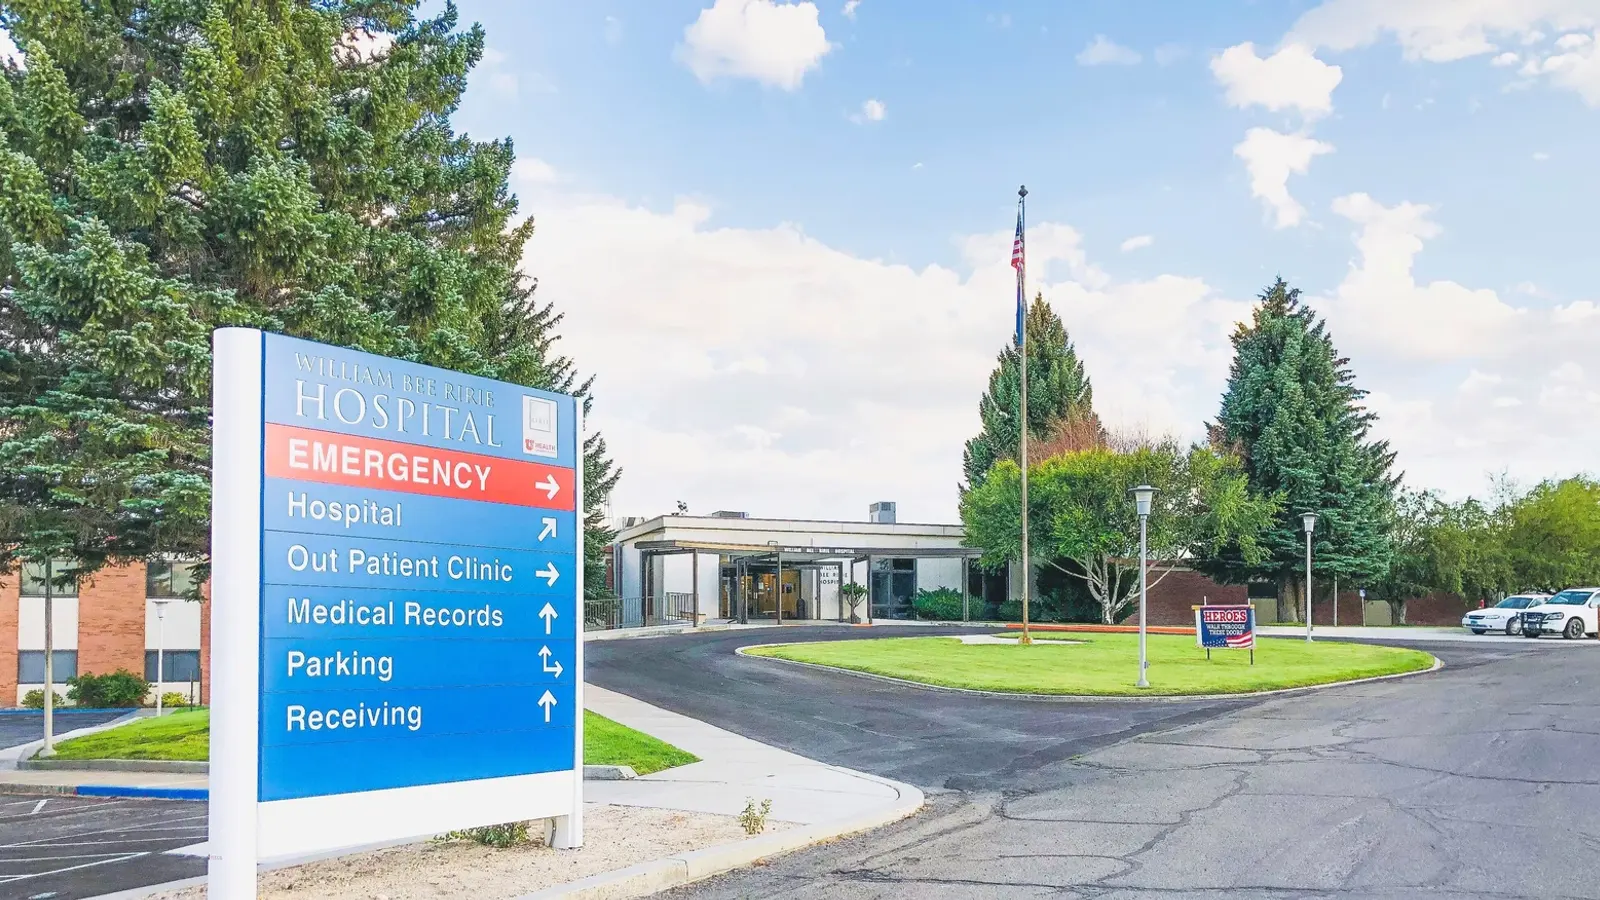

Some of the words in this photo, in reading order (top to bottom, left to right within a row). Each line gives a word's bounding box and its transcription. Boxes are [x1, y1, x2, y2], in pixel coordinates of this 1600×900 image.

[295, 352, 394, 390] WILLIAM
[403, 374, 436, 396] BEE
[445, 383, 495, 408] RIRIE
[295, 380, 503, 448] HOSPITAL
[535, 442, 555, 451] HEALTH
[288, 439, 491, 491] EMERGENCY
[288, 491, 402, 528] Hospital
[287, 544, 338, 573] Out
[349, 549, 438, 577] Patient
[447, 555, 513, 582] Clinic
[288, 598, 393, 625] Medical
[404, 601, 503, 627] Records
[1204, 610, 1247, 622] HEROES
[287, 650, 393, 682] Parking
[287, 701, 422, 731] Receiving
